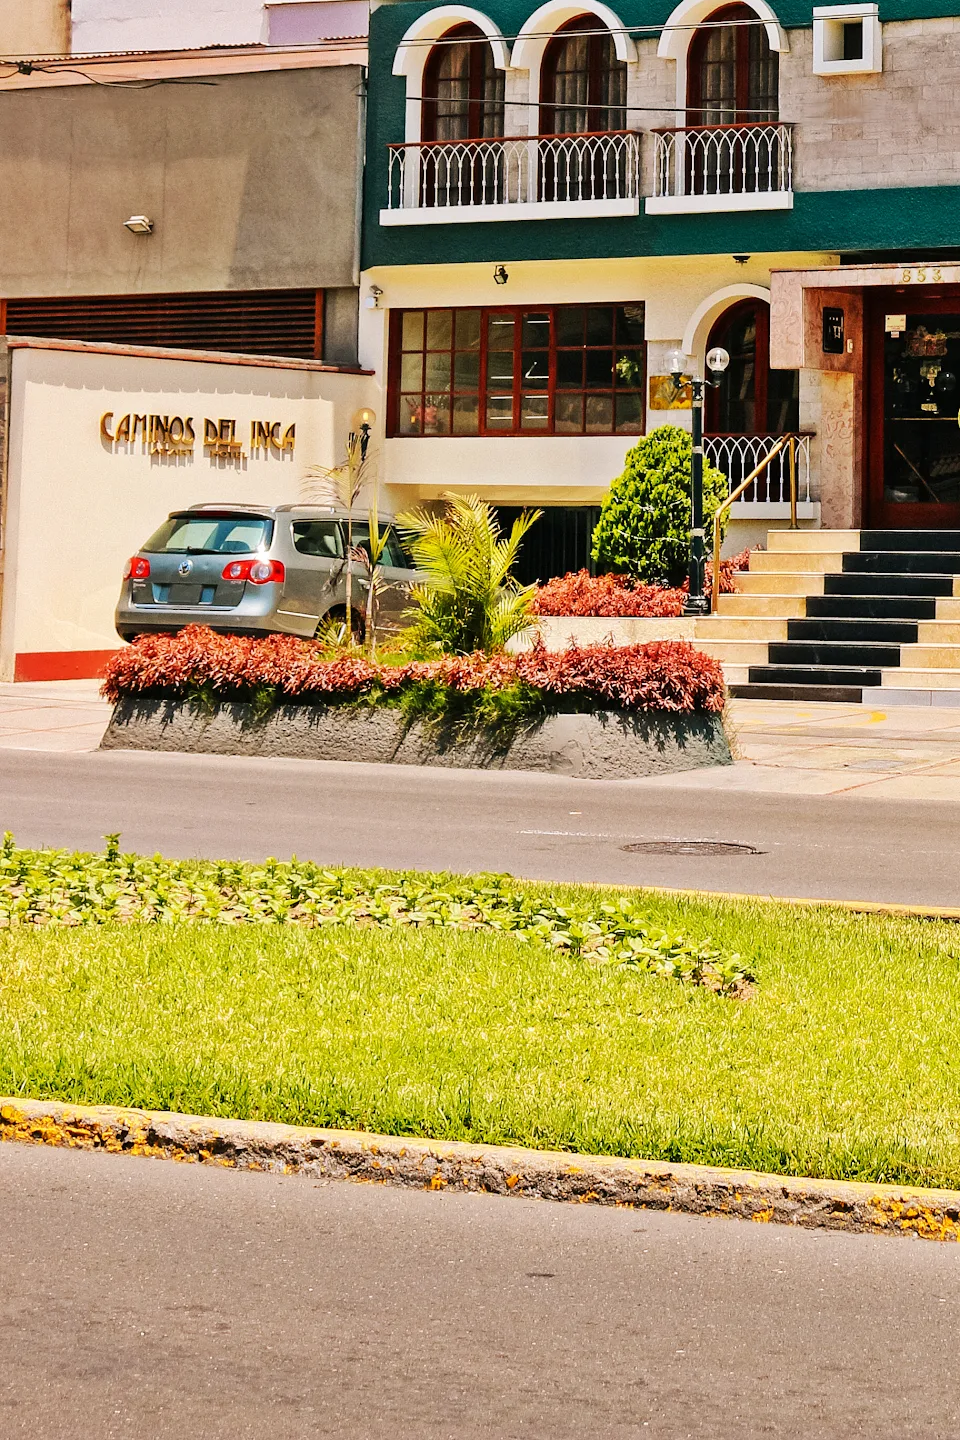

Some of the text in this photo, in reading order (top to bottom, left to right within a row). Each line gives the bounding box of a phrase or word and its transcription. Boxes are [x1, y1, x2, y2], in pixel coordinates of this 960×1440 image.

[100, 412, 296, 450] CAMINOS DEL INCA
